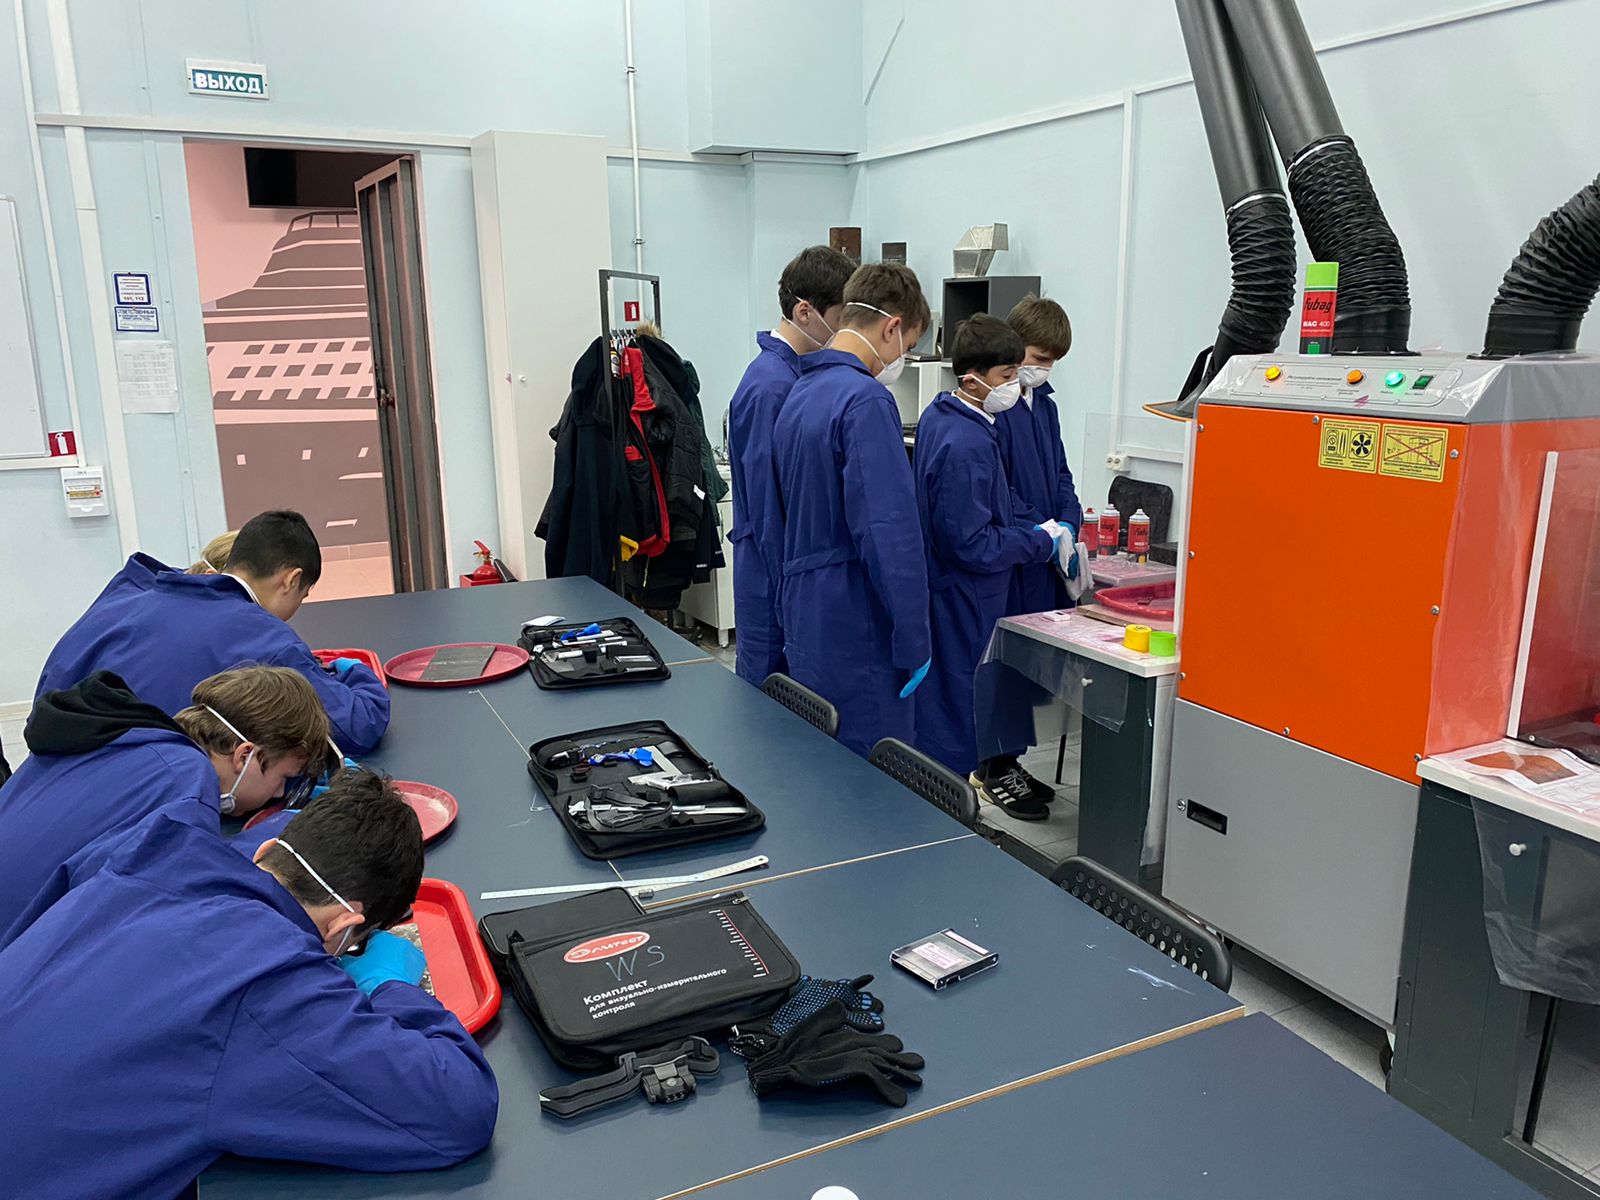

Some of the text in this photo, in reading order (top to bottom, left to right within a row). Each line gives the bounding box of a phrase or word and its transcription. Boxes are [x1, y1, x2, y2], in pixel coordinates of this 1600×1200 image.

[195, 72, 261, 93] ВЫХОД
[583, 980, 648, 1005] Комплект
[589, 968, 727, 1014] для визуально-измерительного
[592, 1001, 636, 1020] контроля
